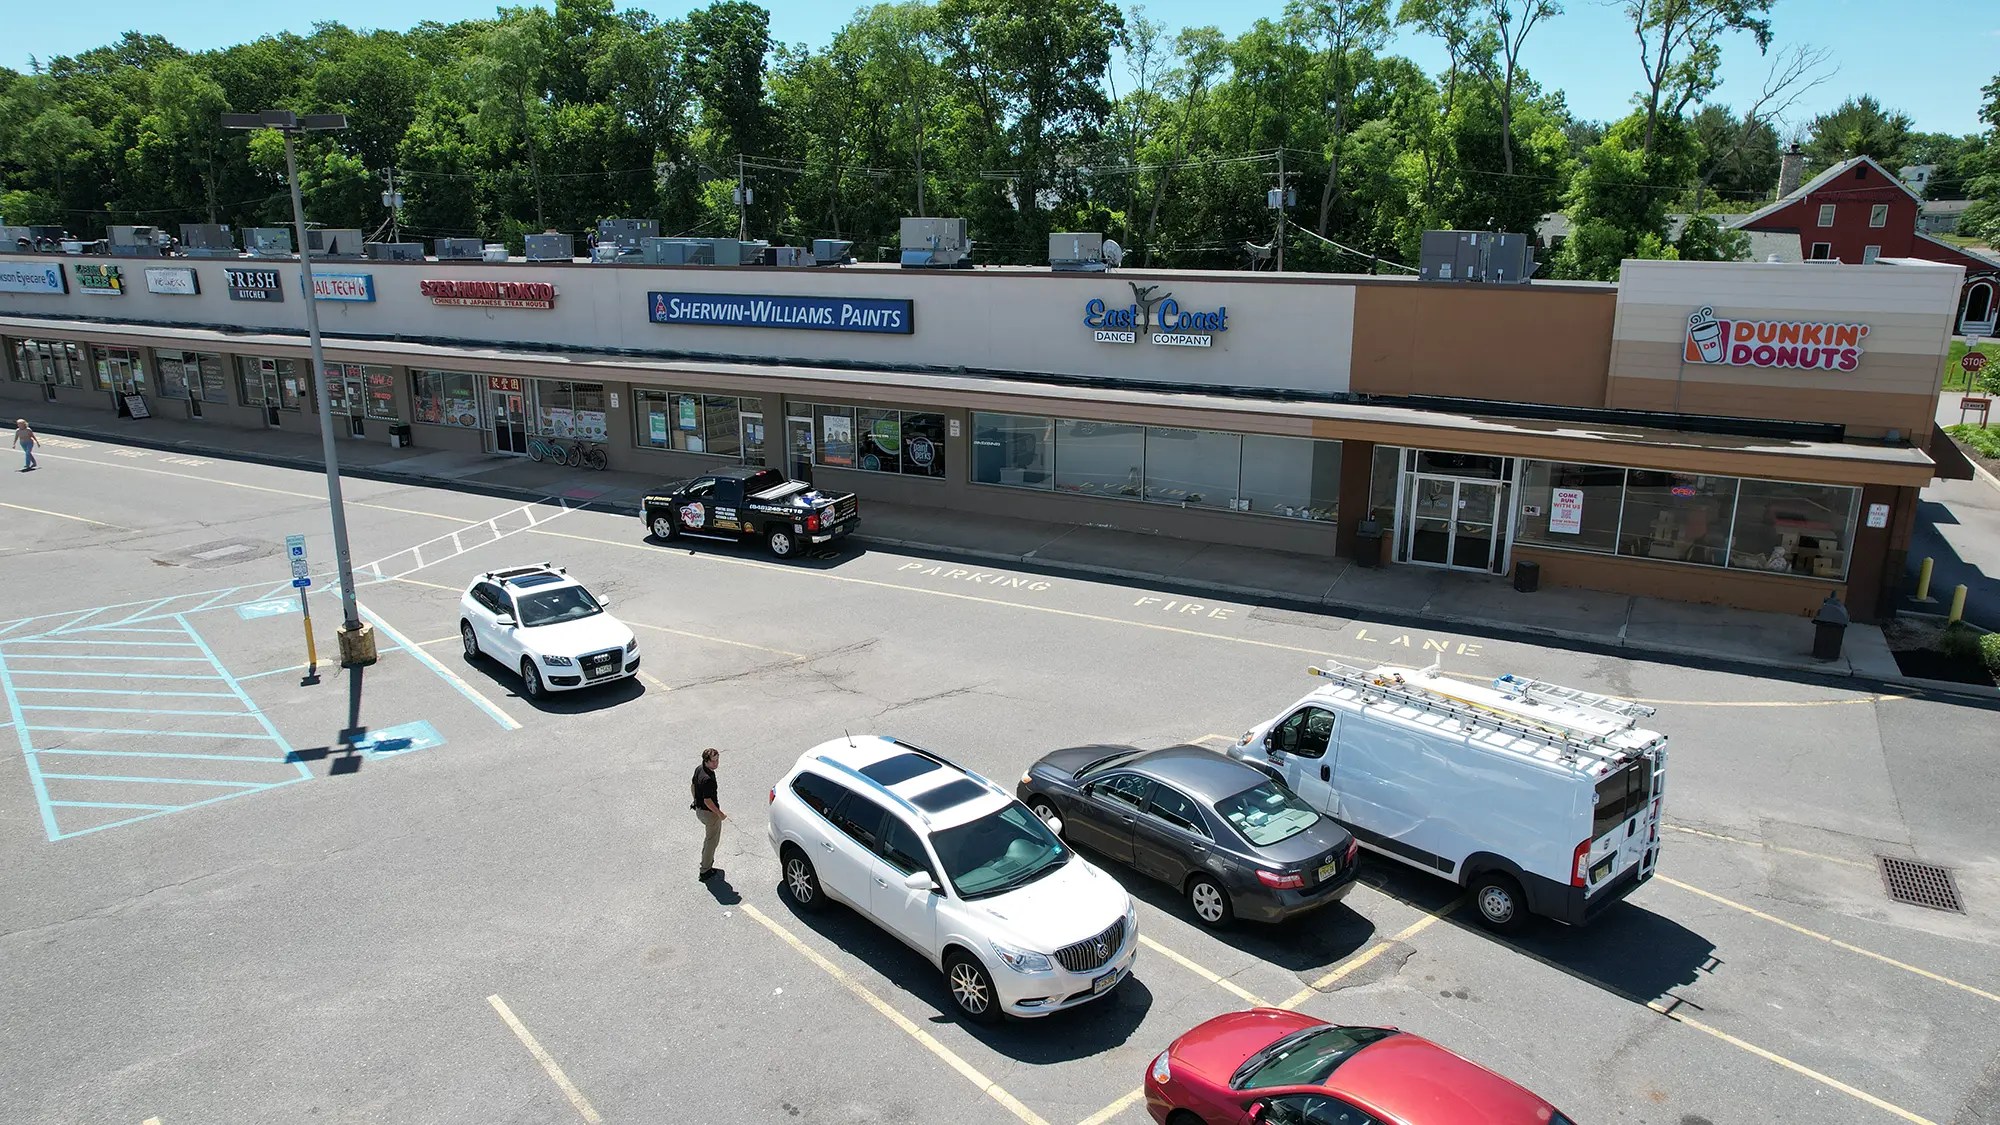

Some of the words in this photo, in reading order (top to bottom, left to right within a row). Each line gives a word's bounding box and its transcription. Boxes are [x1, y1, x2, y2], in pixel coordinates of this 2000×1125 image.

[16, 271, 46, 286] Eyecare
[228, 271, 277, 289] FRESH
[239, 290, 266, 299] KITCHEN
[312, 281, 331, 295] AIL
[331, 281, 357, 296] TECH
[420, 280, 499, 299] SZECHUAN
[500, 282, 554, 300] TOKYO
[839, 303, 901, 328] PAINTS
[1083, 298, 1140, 329] East
[1157, 298, 1229, 332] Coast
[1096, 332, 1133, 343] DANCE
[1153, 334, 1210, 346] COMPANY
[1734, 321, 1869, 347] DUNKIN'
[1731, 343, 1859, 371] DONUTS
[1963, 357, 1986, 367] STOP
[1671, 487, 1697, 497] OPEN
[898, 562, 1052, 592] PARKING
[1133, 596, 1235, 621] FIRE
[1355, 627, 1484, 657] LANE
